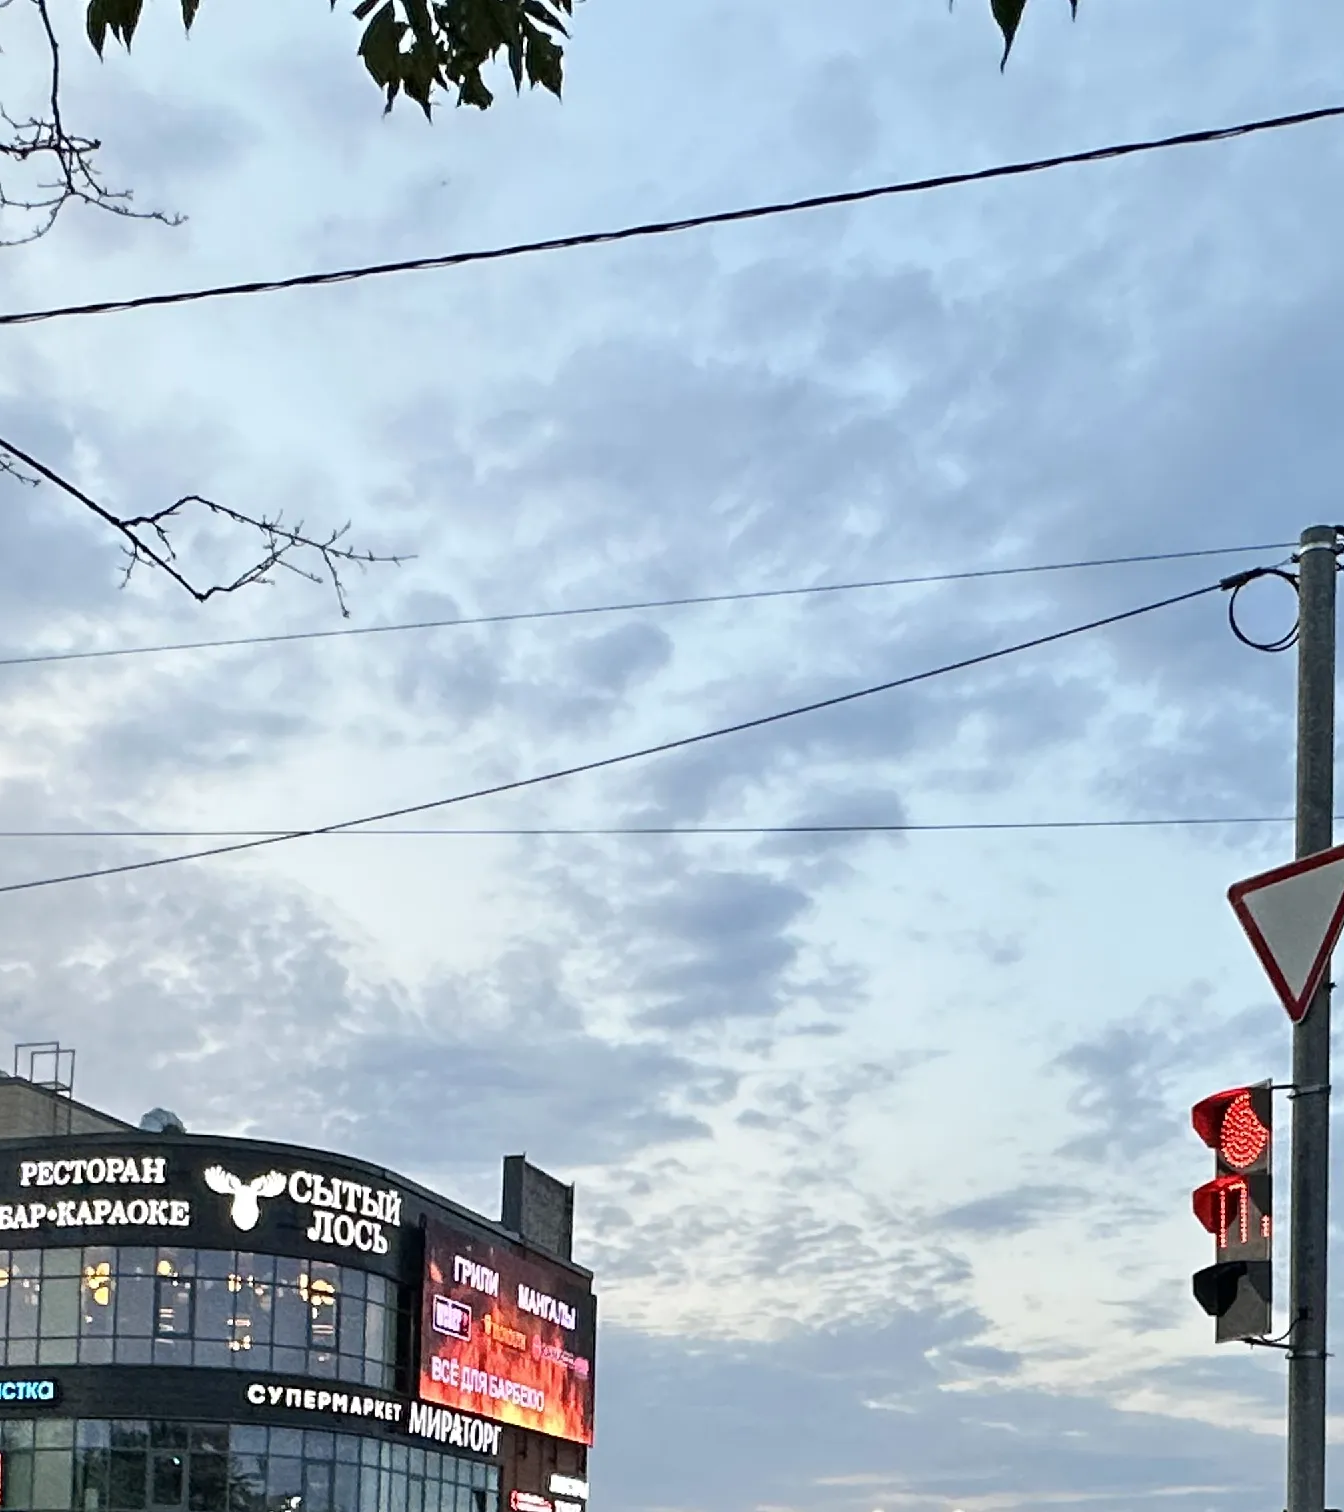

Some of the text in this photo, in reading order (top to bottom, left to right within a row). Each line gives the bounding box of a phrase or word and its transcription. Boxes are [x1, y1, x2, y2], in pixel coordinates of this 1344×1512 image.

[20, 1157, 166, 1188] РЕСТОРАН
[288, 1170, 402, 1227] СЫТЫЙ
[306, 1209, 389, 1255] ЛОСЬ
[454, 1255, 500, 1298] ГРИЛИ
[518, 1283, 576, 1331] МАНГАЛЫ
[460, 1366, 488, 1397] ДЛЯ
[488, 1374, 545, 1413] БАРБЕКЮ
[246, 1383, 503, 1456] СУПЕРМАРКЕТ МИРАТОРГ
